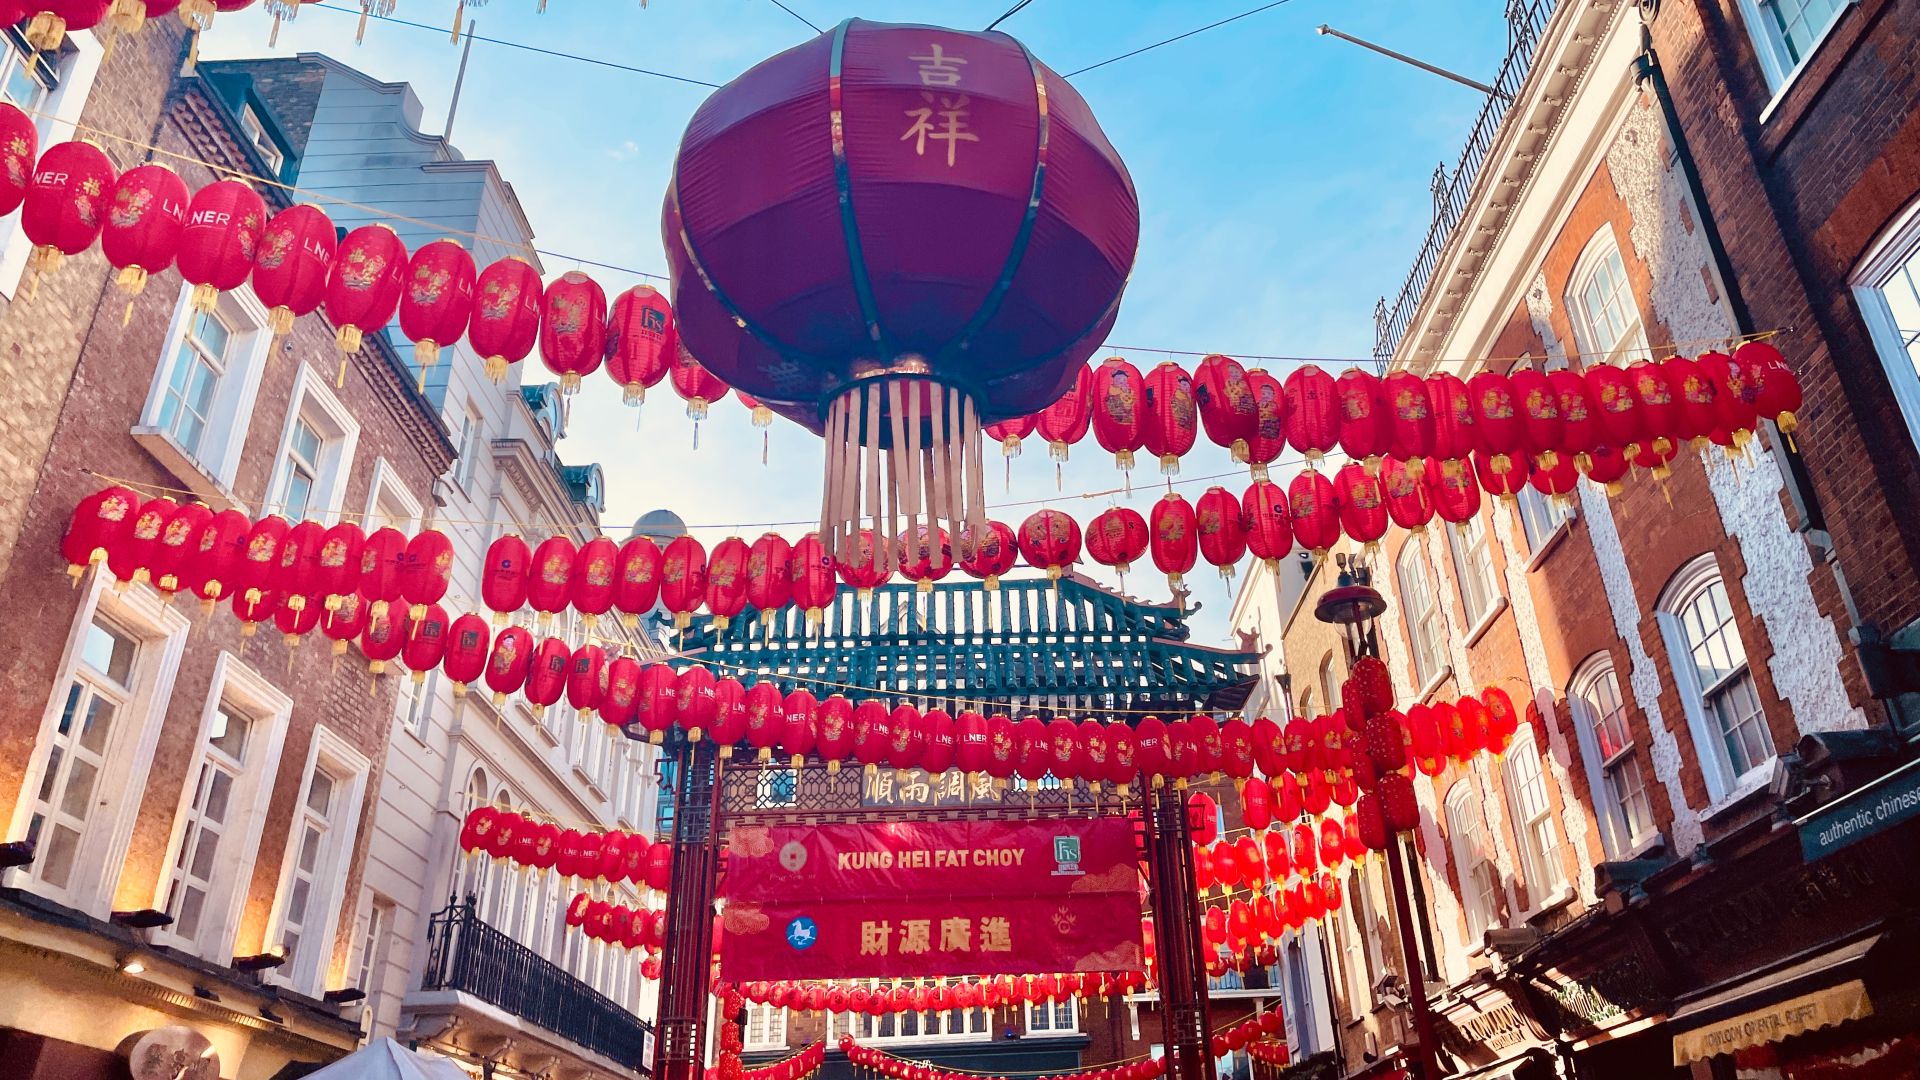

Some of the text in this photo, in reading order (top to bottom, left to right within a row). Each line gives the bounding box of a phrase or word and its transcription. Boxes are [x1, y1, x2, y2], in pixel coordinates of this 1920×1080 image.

[900, 43, 980, 167] 吉祥
[963, 732, 988, 744] LNER
[1819, 809, 1875, 847] authentic
[838, 848, 1025, 870] KUNG HEI FAT CHOY
[860, 916, 1012, 956] 財源廣進
